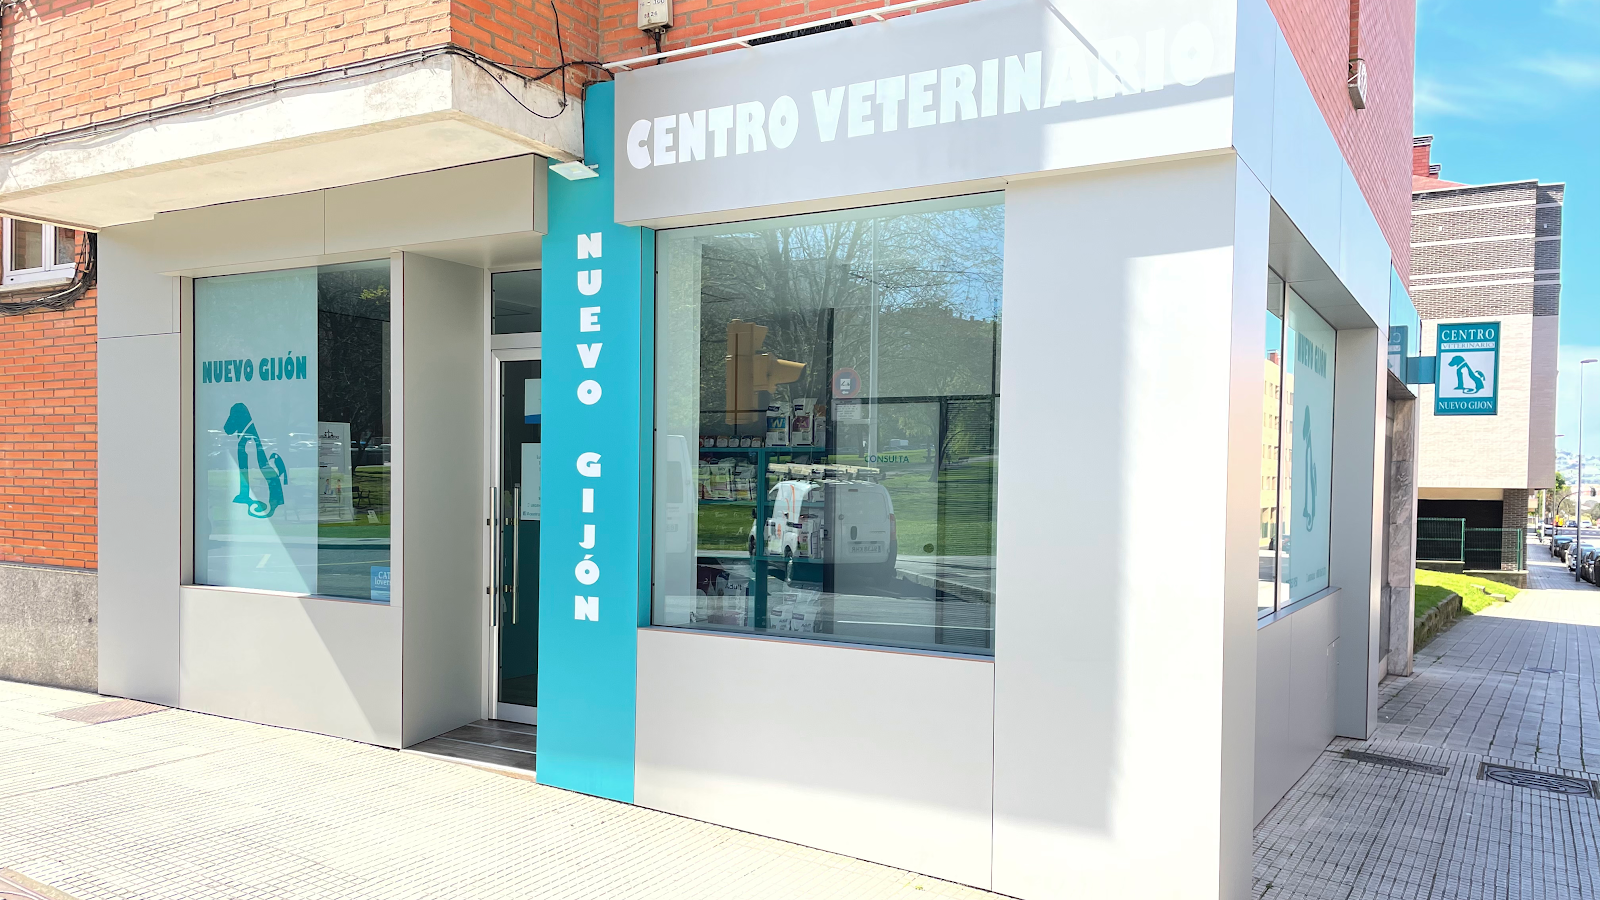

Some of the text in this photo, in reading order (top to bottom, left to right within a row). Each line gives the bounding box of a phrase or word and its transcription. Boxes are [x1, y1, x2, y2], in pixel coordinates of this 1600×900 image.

[626, 20, 1215, 169] CENTRO VETERINARIO
[1441, 328, 1495, 341] CENTRO
[202, 350, 307, 383] NUEVO GIJÓN
[1438, 401, 1467, 410] NUEVO
[574, 232, 603, 622] NUEVO GIJÓN
[864, 454, 909, 464] CONSULTA
